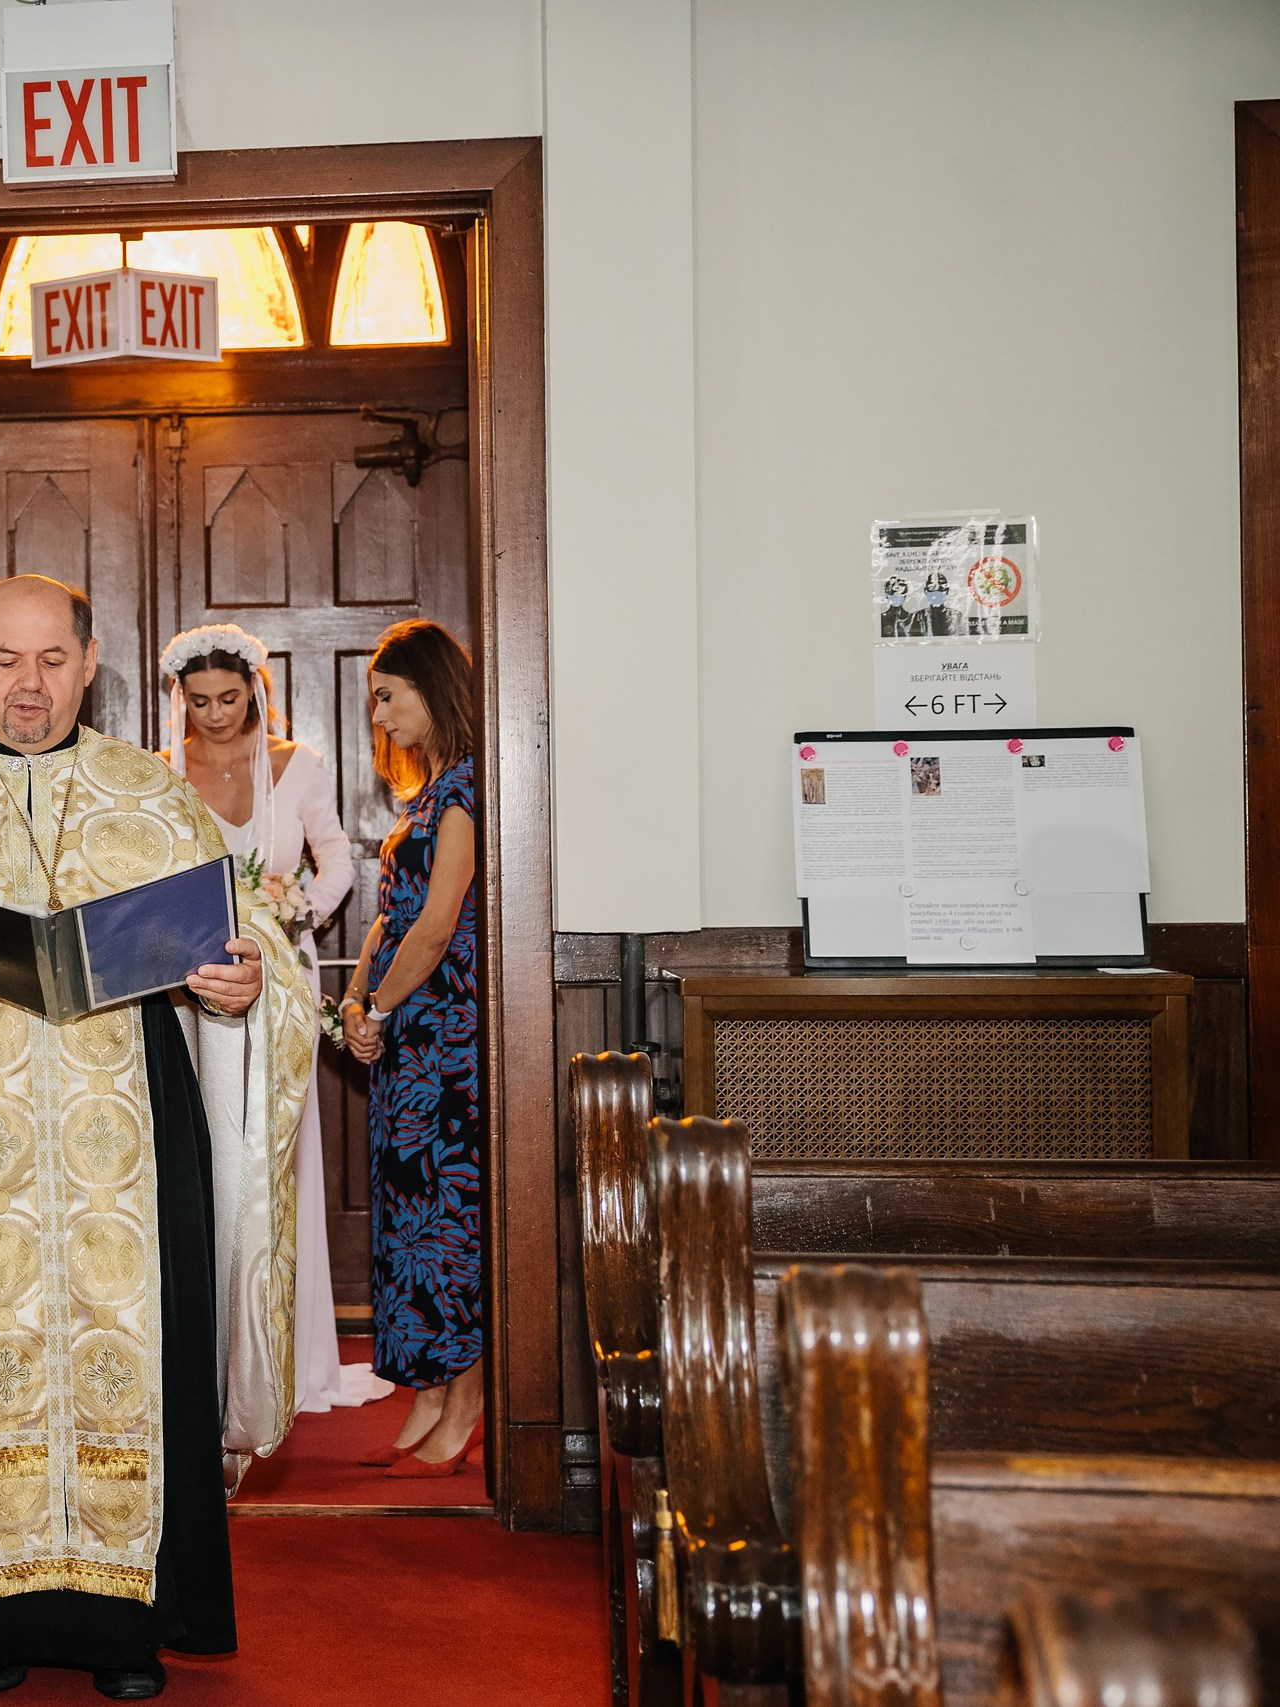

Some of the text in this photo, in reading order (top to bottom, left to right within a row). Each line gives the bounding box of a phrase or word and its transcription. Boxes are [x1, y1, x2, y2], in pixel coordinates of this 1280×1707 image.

[23, 76, 147, 168] EXIT
[44, 282, 111, 355] EXIT
[140, 281, 204, 349] EXIT
[909, 673, 1001, 683] ЗБЕРІГАЙТЕ ВІДСТАНЬ
[941, 662, 968, 670] УВАГА
[931, 694, 981, 714] 6 FT
